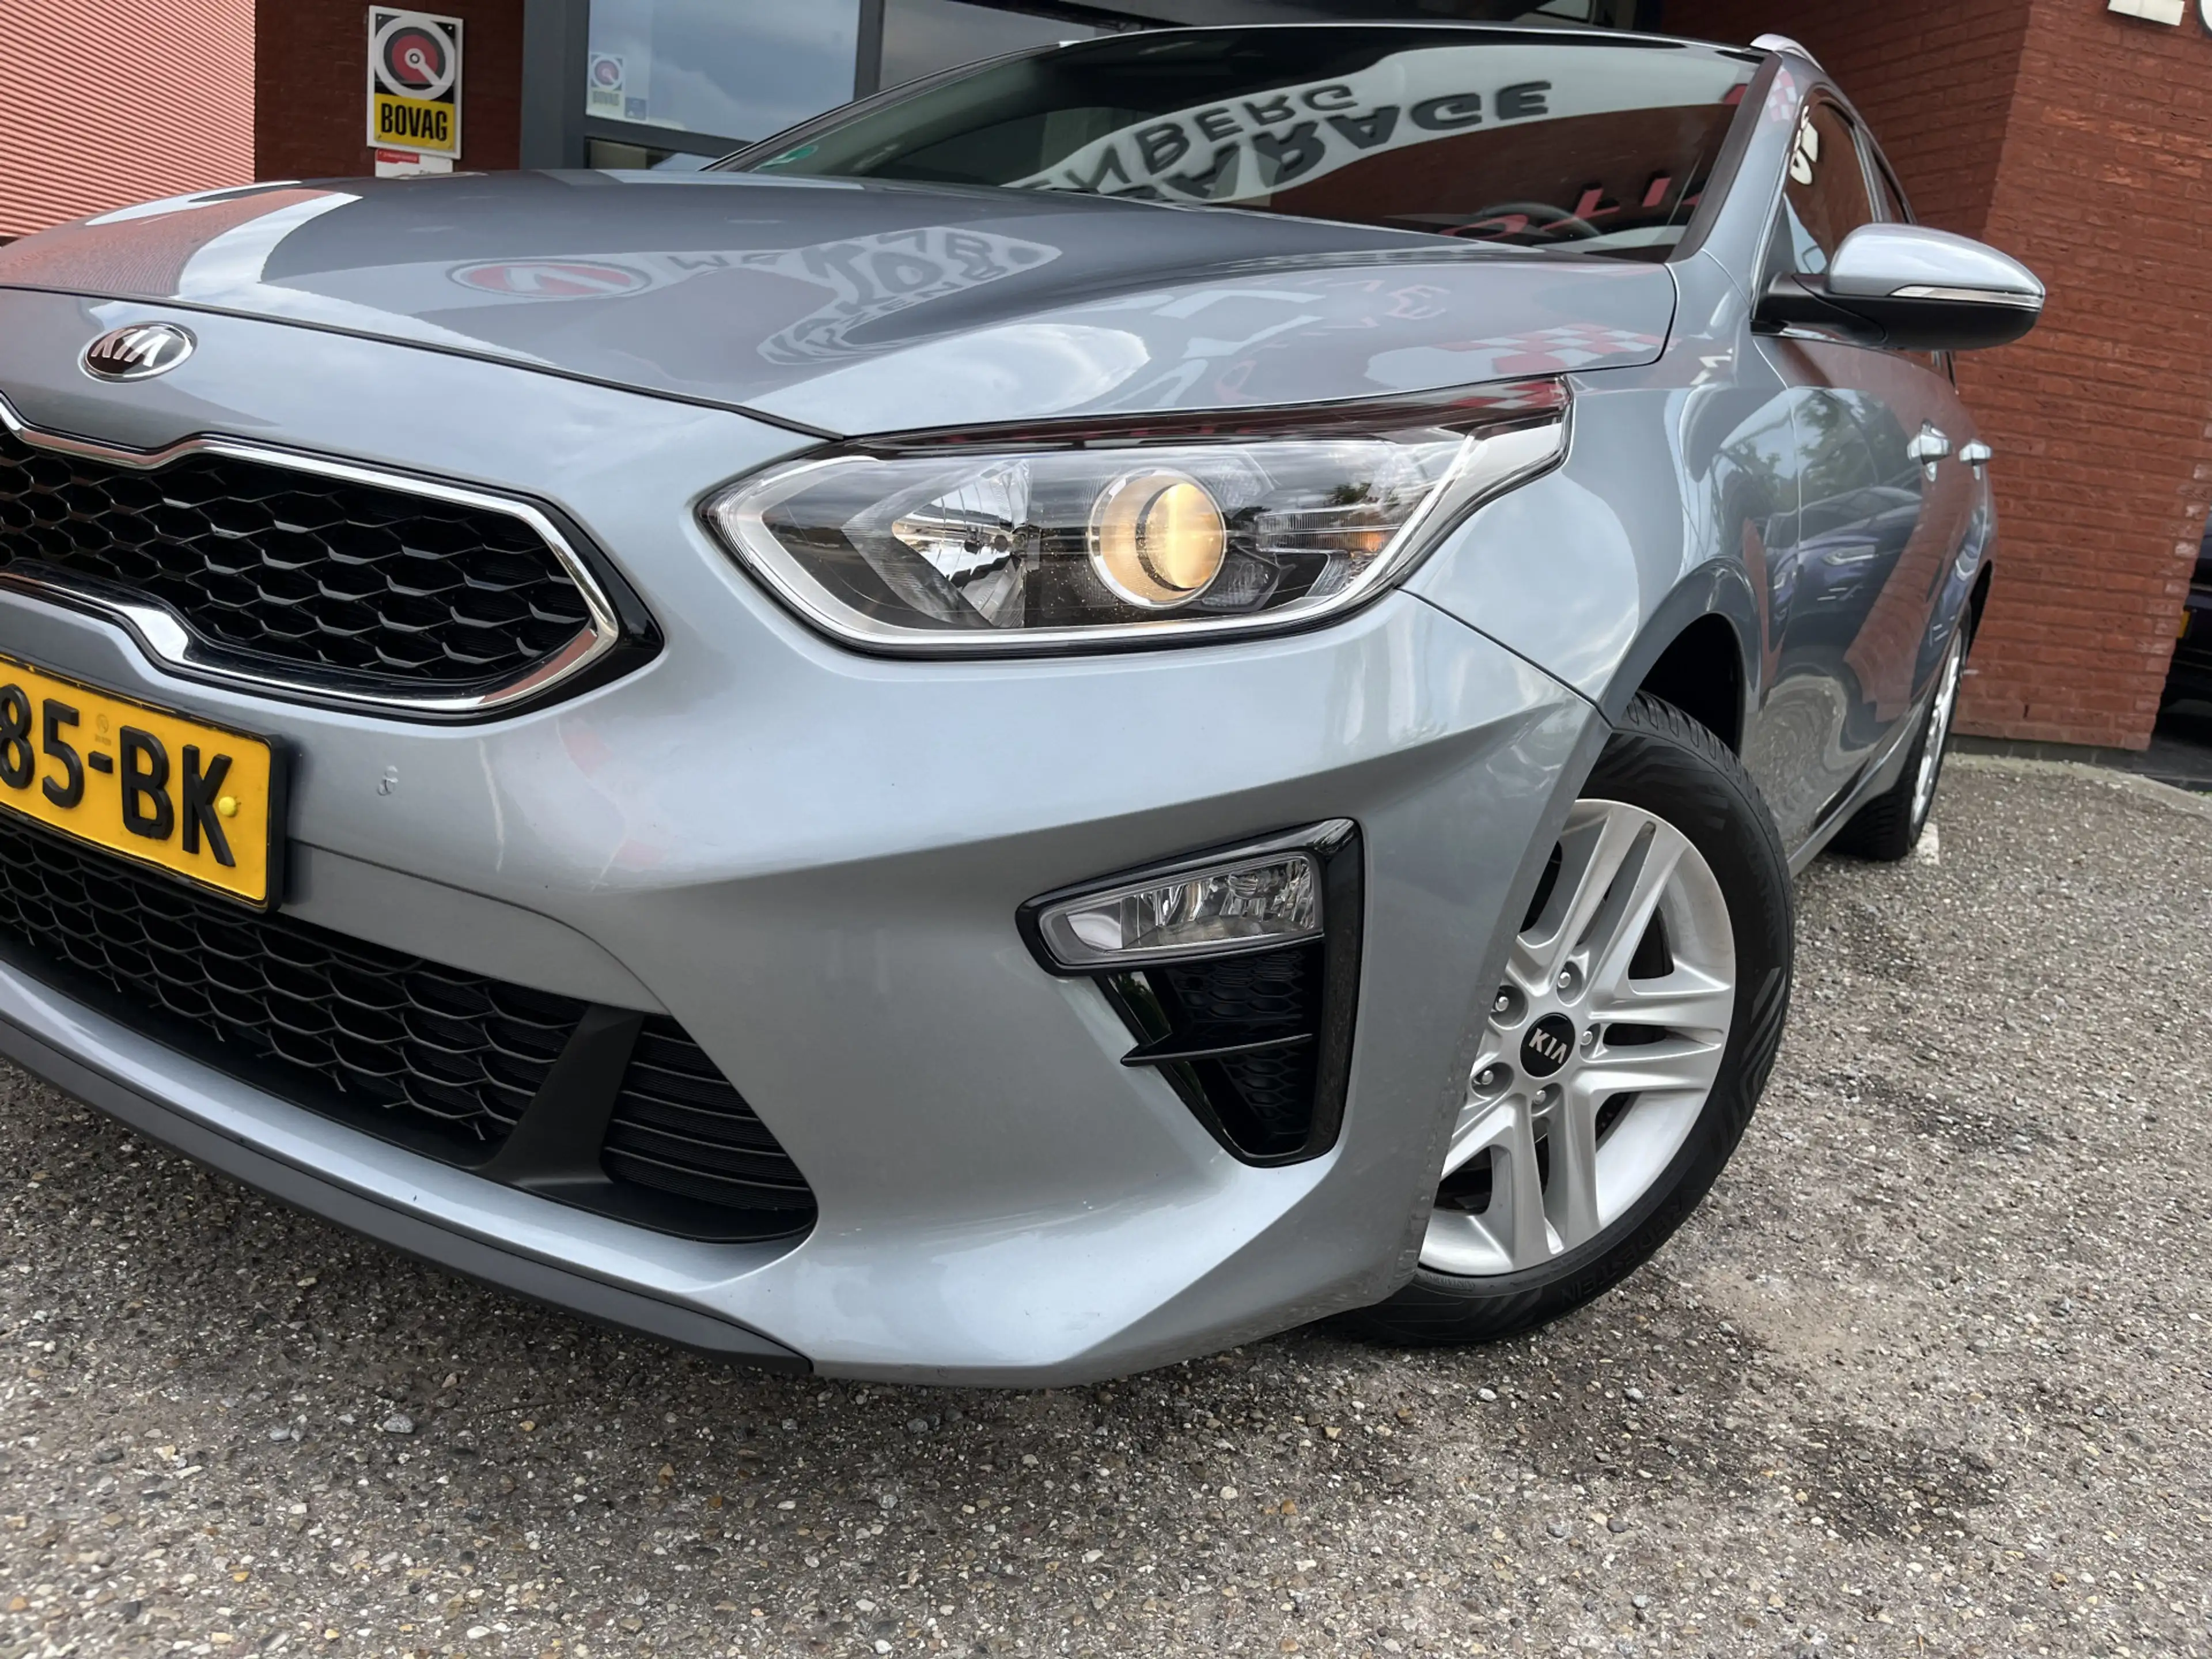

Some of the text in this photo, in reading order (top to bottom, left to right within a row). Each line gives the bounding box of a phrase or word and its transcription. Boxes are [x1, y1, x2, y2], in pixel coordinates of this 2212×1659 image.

[381, 103, 448, 142] BOVAG
[90, 327, 171, 368] KIA
[0, 683, 236, 868] 85-BK
[1528, 1027, 1567, 1065] KIA
